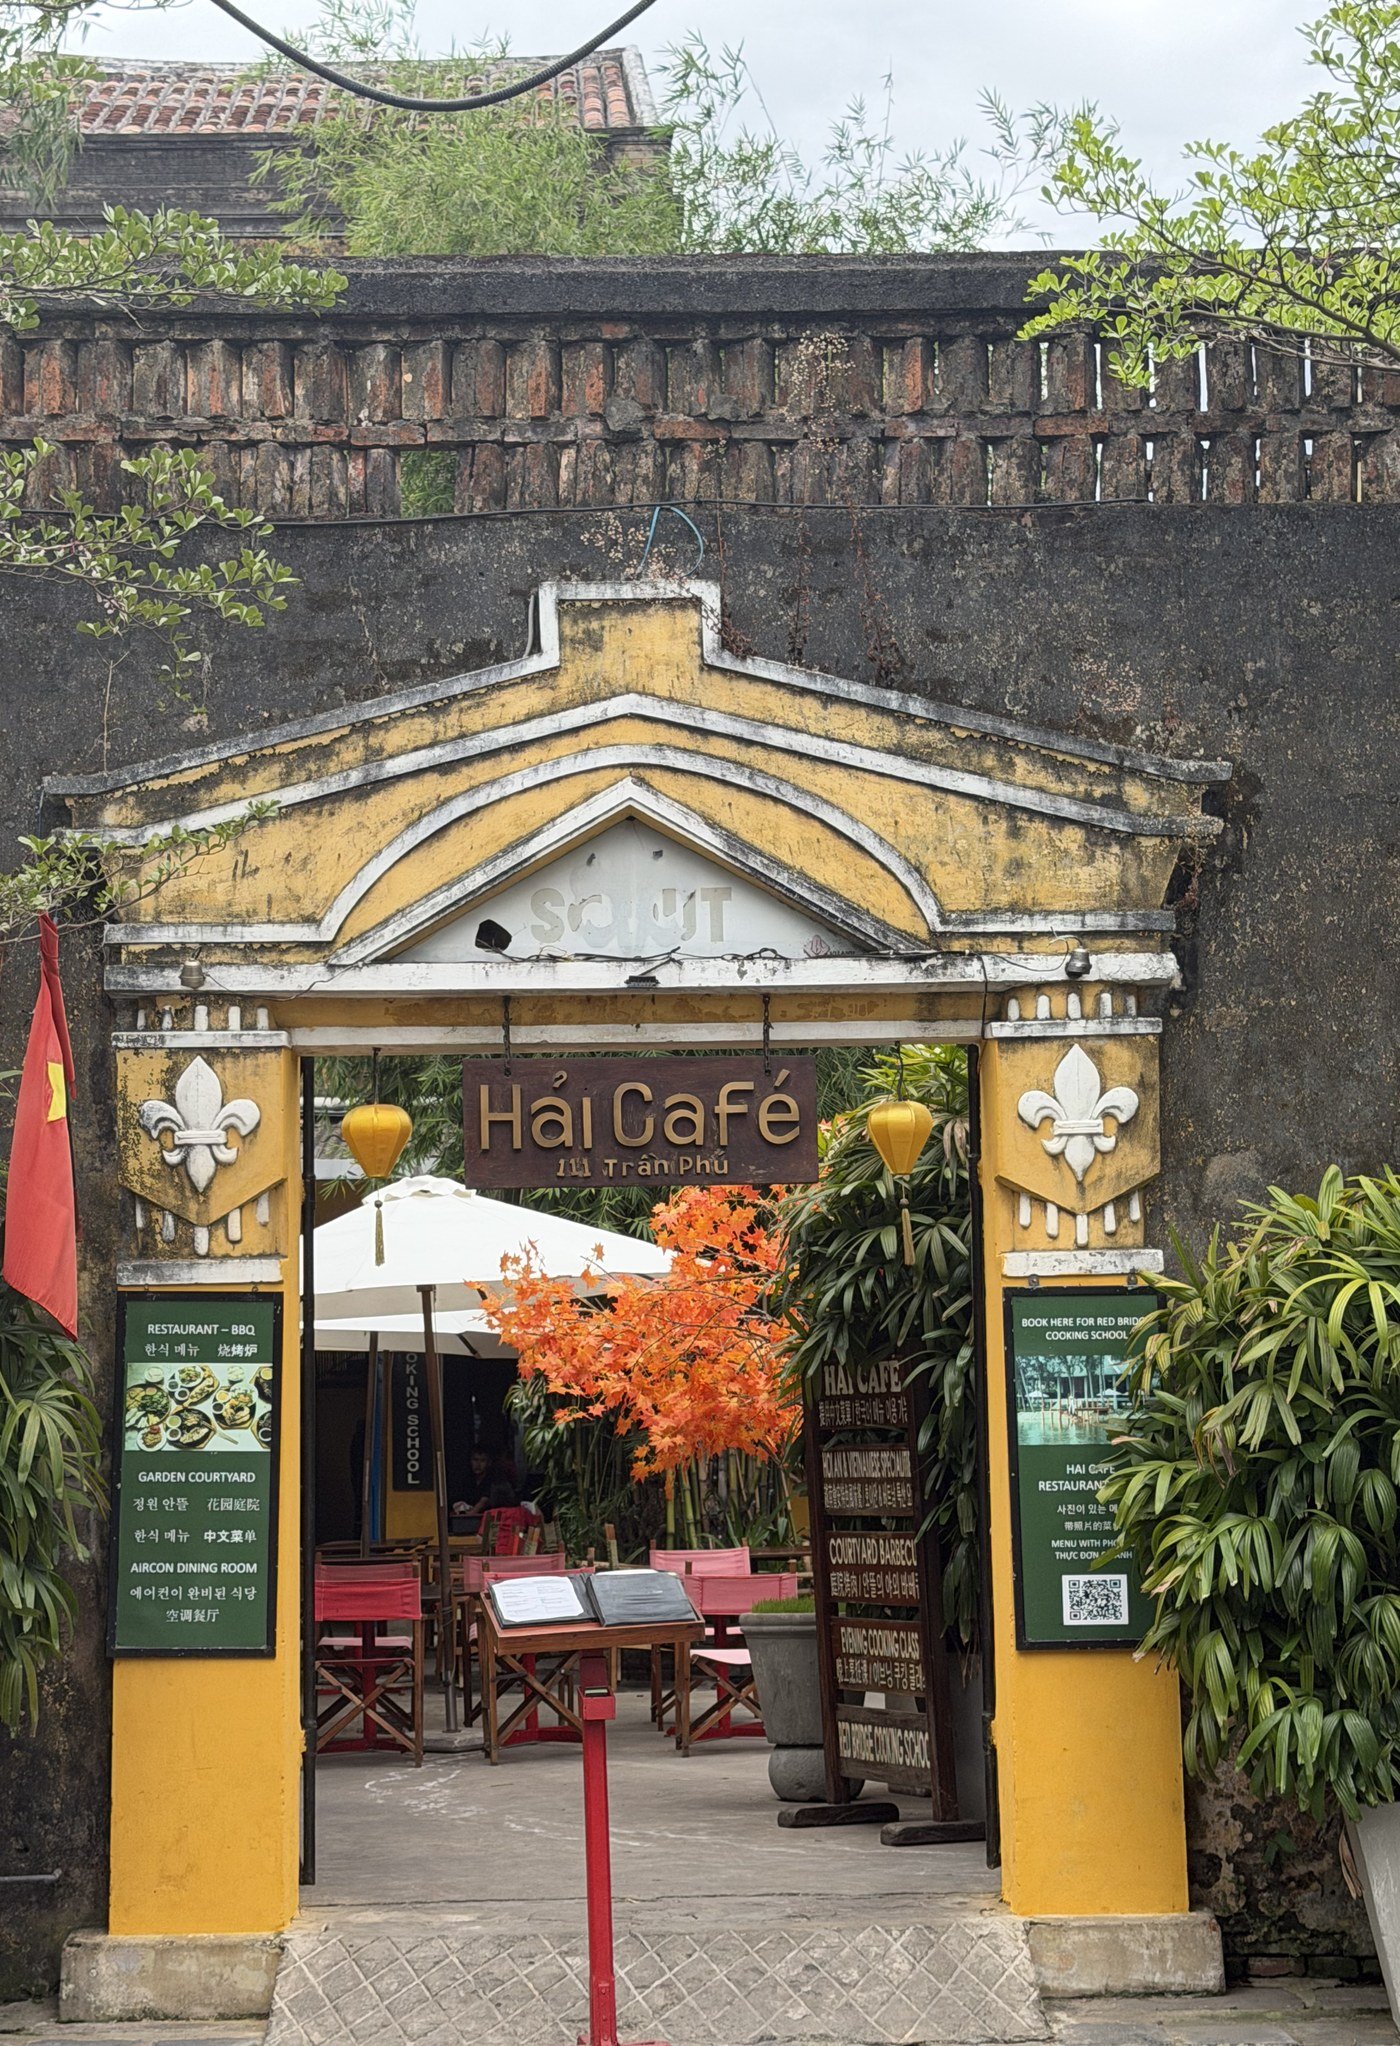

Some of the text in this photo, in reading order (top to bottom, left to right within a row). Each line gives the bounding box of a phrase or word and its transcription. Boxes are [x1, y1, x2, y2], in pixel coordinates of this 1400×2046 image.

[612, 1069, 801, 1147] Café
[603, 1153, 669, 1178] Trần
[1022, 1318, 1048, 1327] BOOK
[1051, 1318, 1073, 1327] HERE
[1076, 1318, 1094, 1327] FOR
[1097, 1317, 1115, 1326] RED
[148, 1324, 219, 1335] RESTAURANT
[231, 1325, 255, 1336] BBQ
[1046, 1331, 1128, 1340] COOKING SCHOOL
[145, 1343, 200, 1357] 한식 메뉴
[407, 1414, 420, 1484] SCHOOL
[1066, 1464, 1086, 1474] HAI
[138, 1472, 256, 1483] GARDEN COURTYARD
[133, 1497, 158, 1511] 정원
[207, 1498, 260, 1511] 花园庭院
[1057, 1504, 1086, 1515] 사진이
[1088, 1504, 1107, 1515] 있는
[134, 1529, 190, 1543] 한식 메뉴
[204, 1530, 257, 1543] 中文菜单
[1052, 1540, 1076, 1548] MENU
[1079, 1540, 1100, 1548] WITH
[829, 1537, 878, 1565] COURTYARD
[1055, 1552, 1078, 1561] THỰC
[130, 1563, 257, 1573] AIRCON DINING ROOM
[187, 1586, 226, 1600] 완비된
[230, 1586, 257, 1600] 식당
[166, 1609, 219, 1622] 空调餐厅
[840, 1627, 920, 1660] EVENING COOKING CLASS
[838, 1721, 851, 1758] RED
[851, 1723, 874, 1761] BRIDGE
[874, 1725, 903, 1765] COOKING
